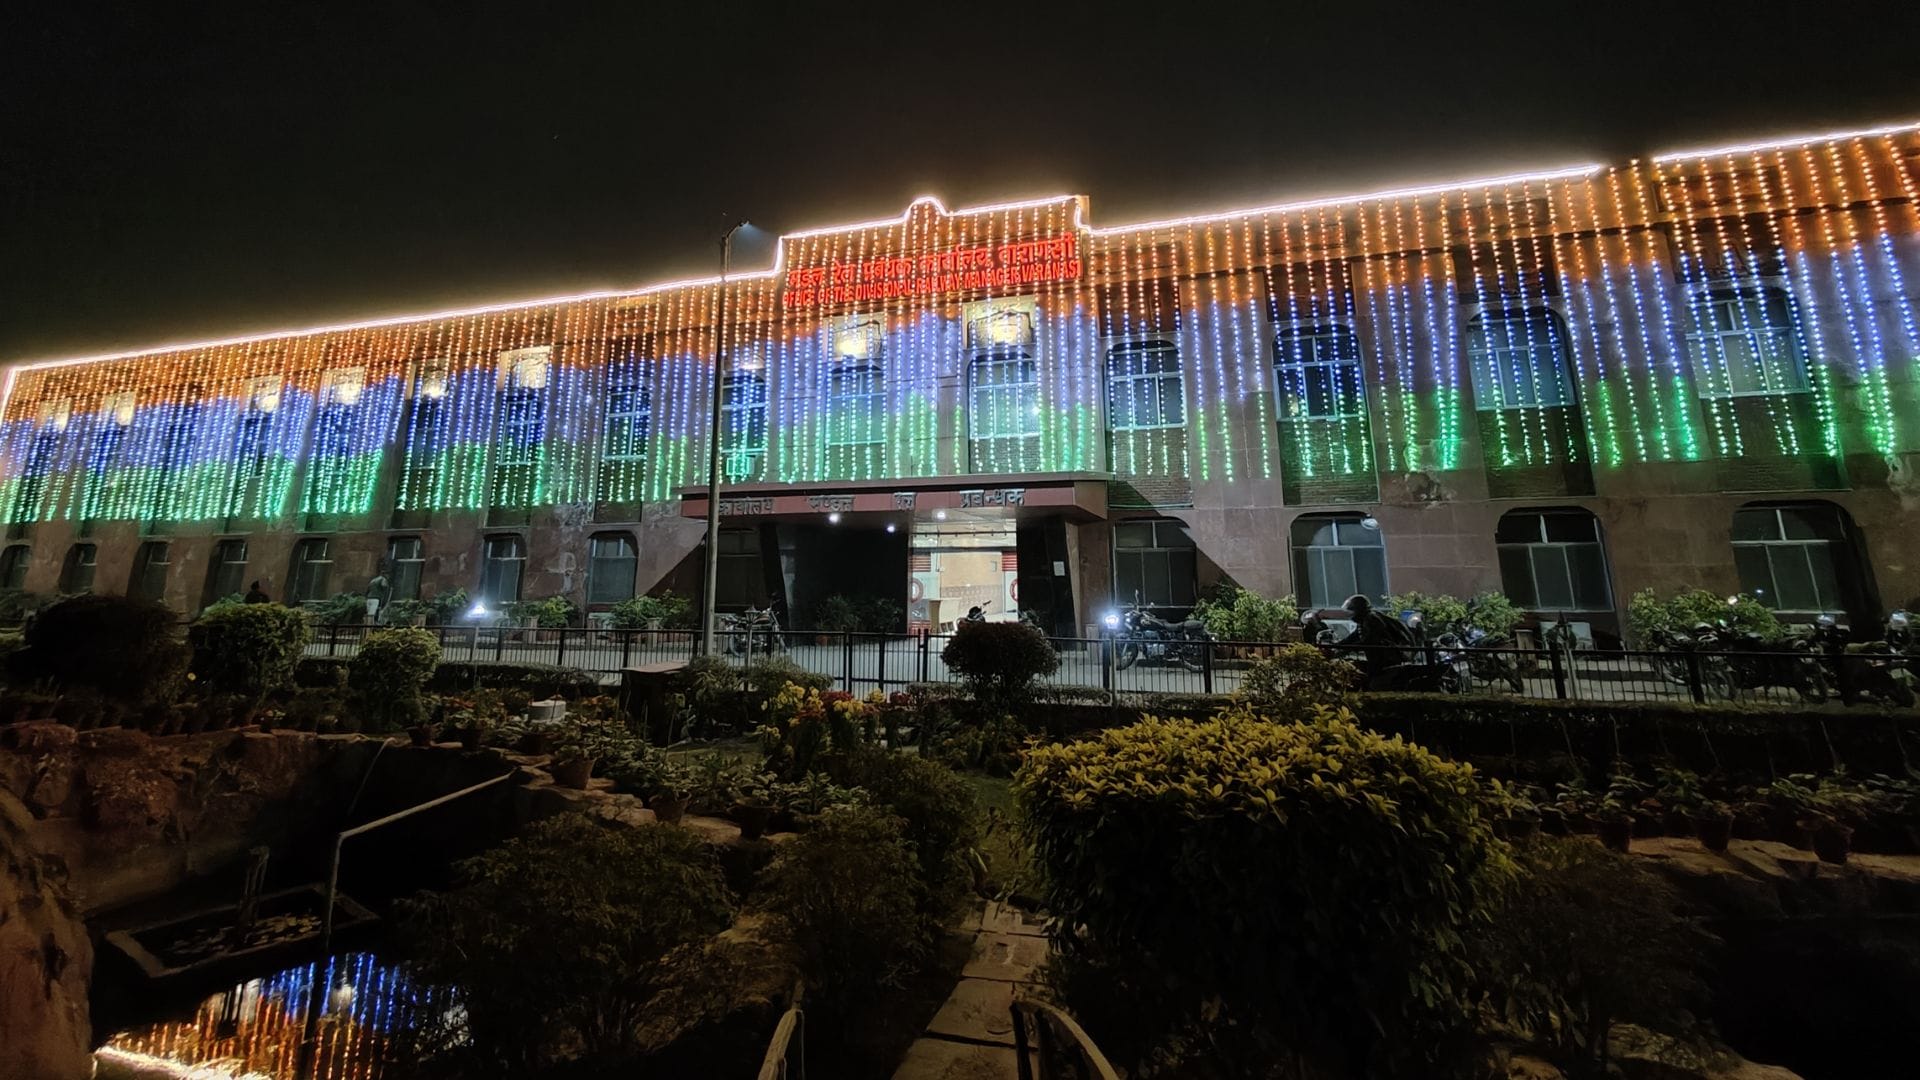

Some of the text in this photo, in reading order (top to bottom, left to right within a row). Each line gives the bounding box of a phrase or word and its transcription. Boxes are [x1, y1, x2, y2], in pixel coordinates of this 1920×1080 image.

[782, 289, 815, 309] OFFICE
[834, 285, 855, 303] THE
[855, 279, 913, 301] DIVISIONAL
[916, 272, 961, 294] RAILWAY
[1021, 260, 1083, 283] VARANASI
